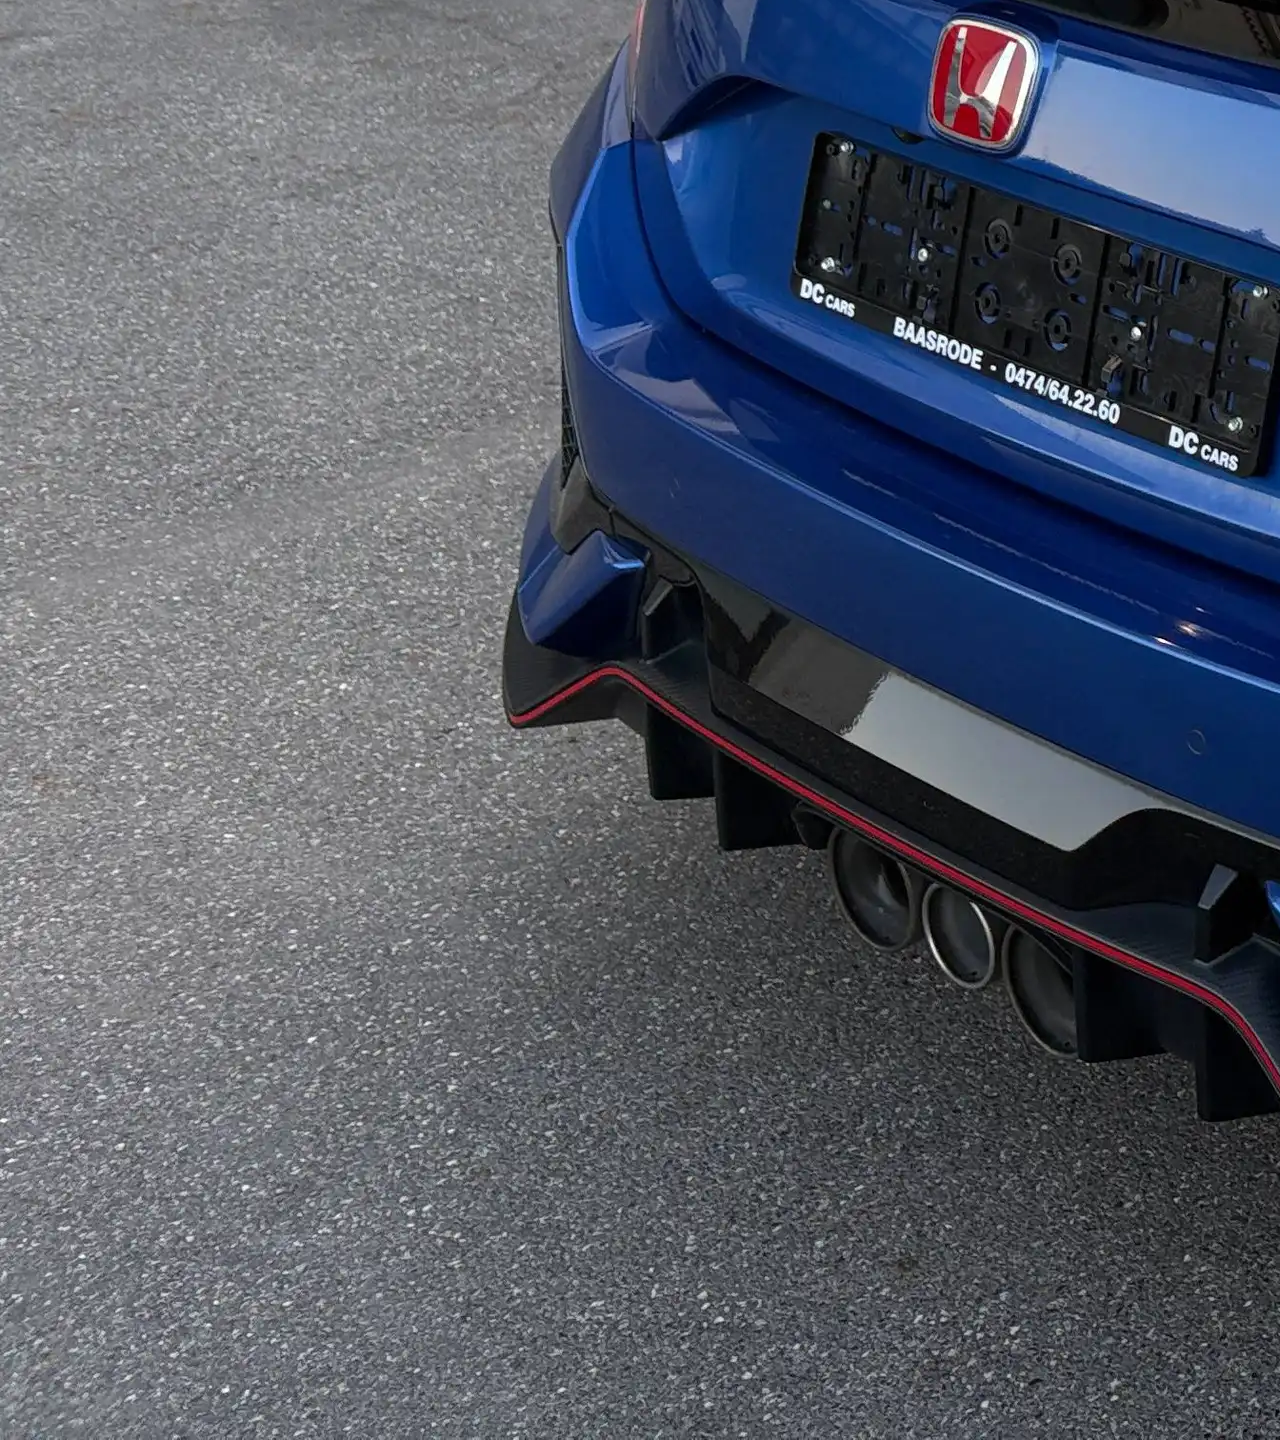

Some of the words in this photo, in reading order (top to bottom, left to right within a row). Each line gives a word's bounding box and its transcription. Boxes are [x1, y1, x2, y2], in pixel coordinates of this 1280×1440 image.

[800, 277, 825, 304] DC
[825, 294, 856, 318] CARS
[893, 316, 984, 370] BAASRODE
[1004, 362, 1121, 425] 0474/64.22.60
[1168, 425, 1199, 455] DC
[1200, 444, 1239, 472] CARS
